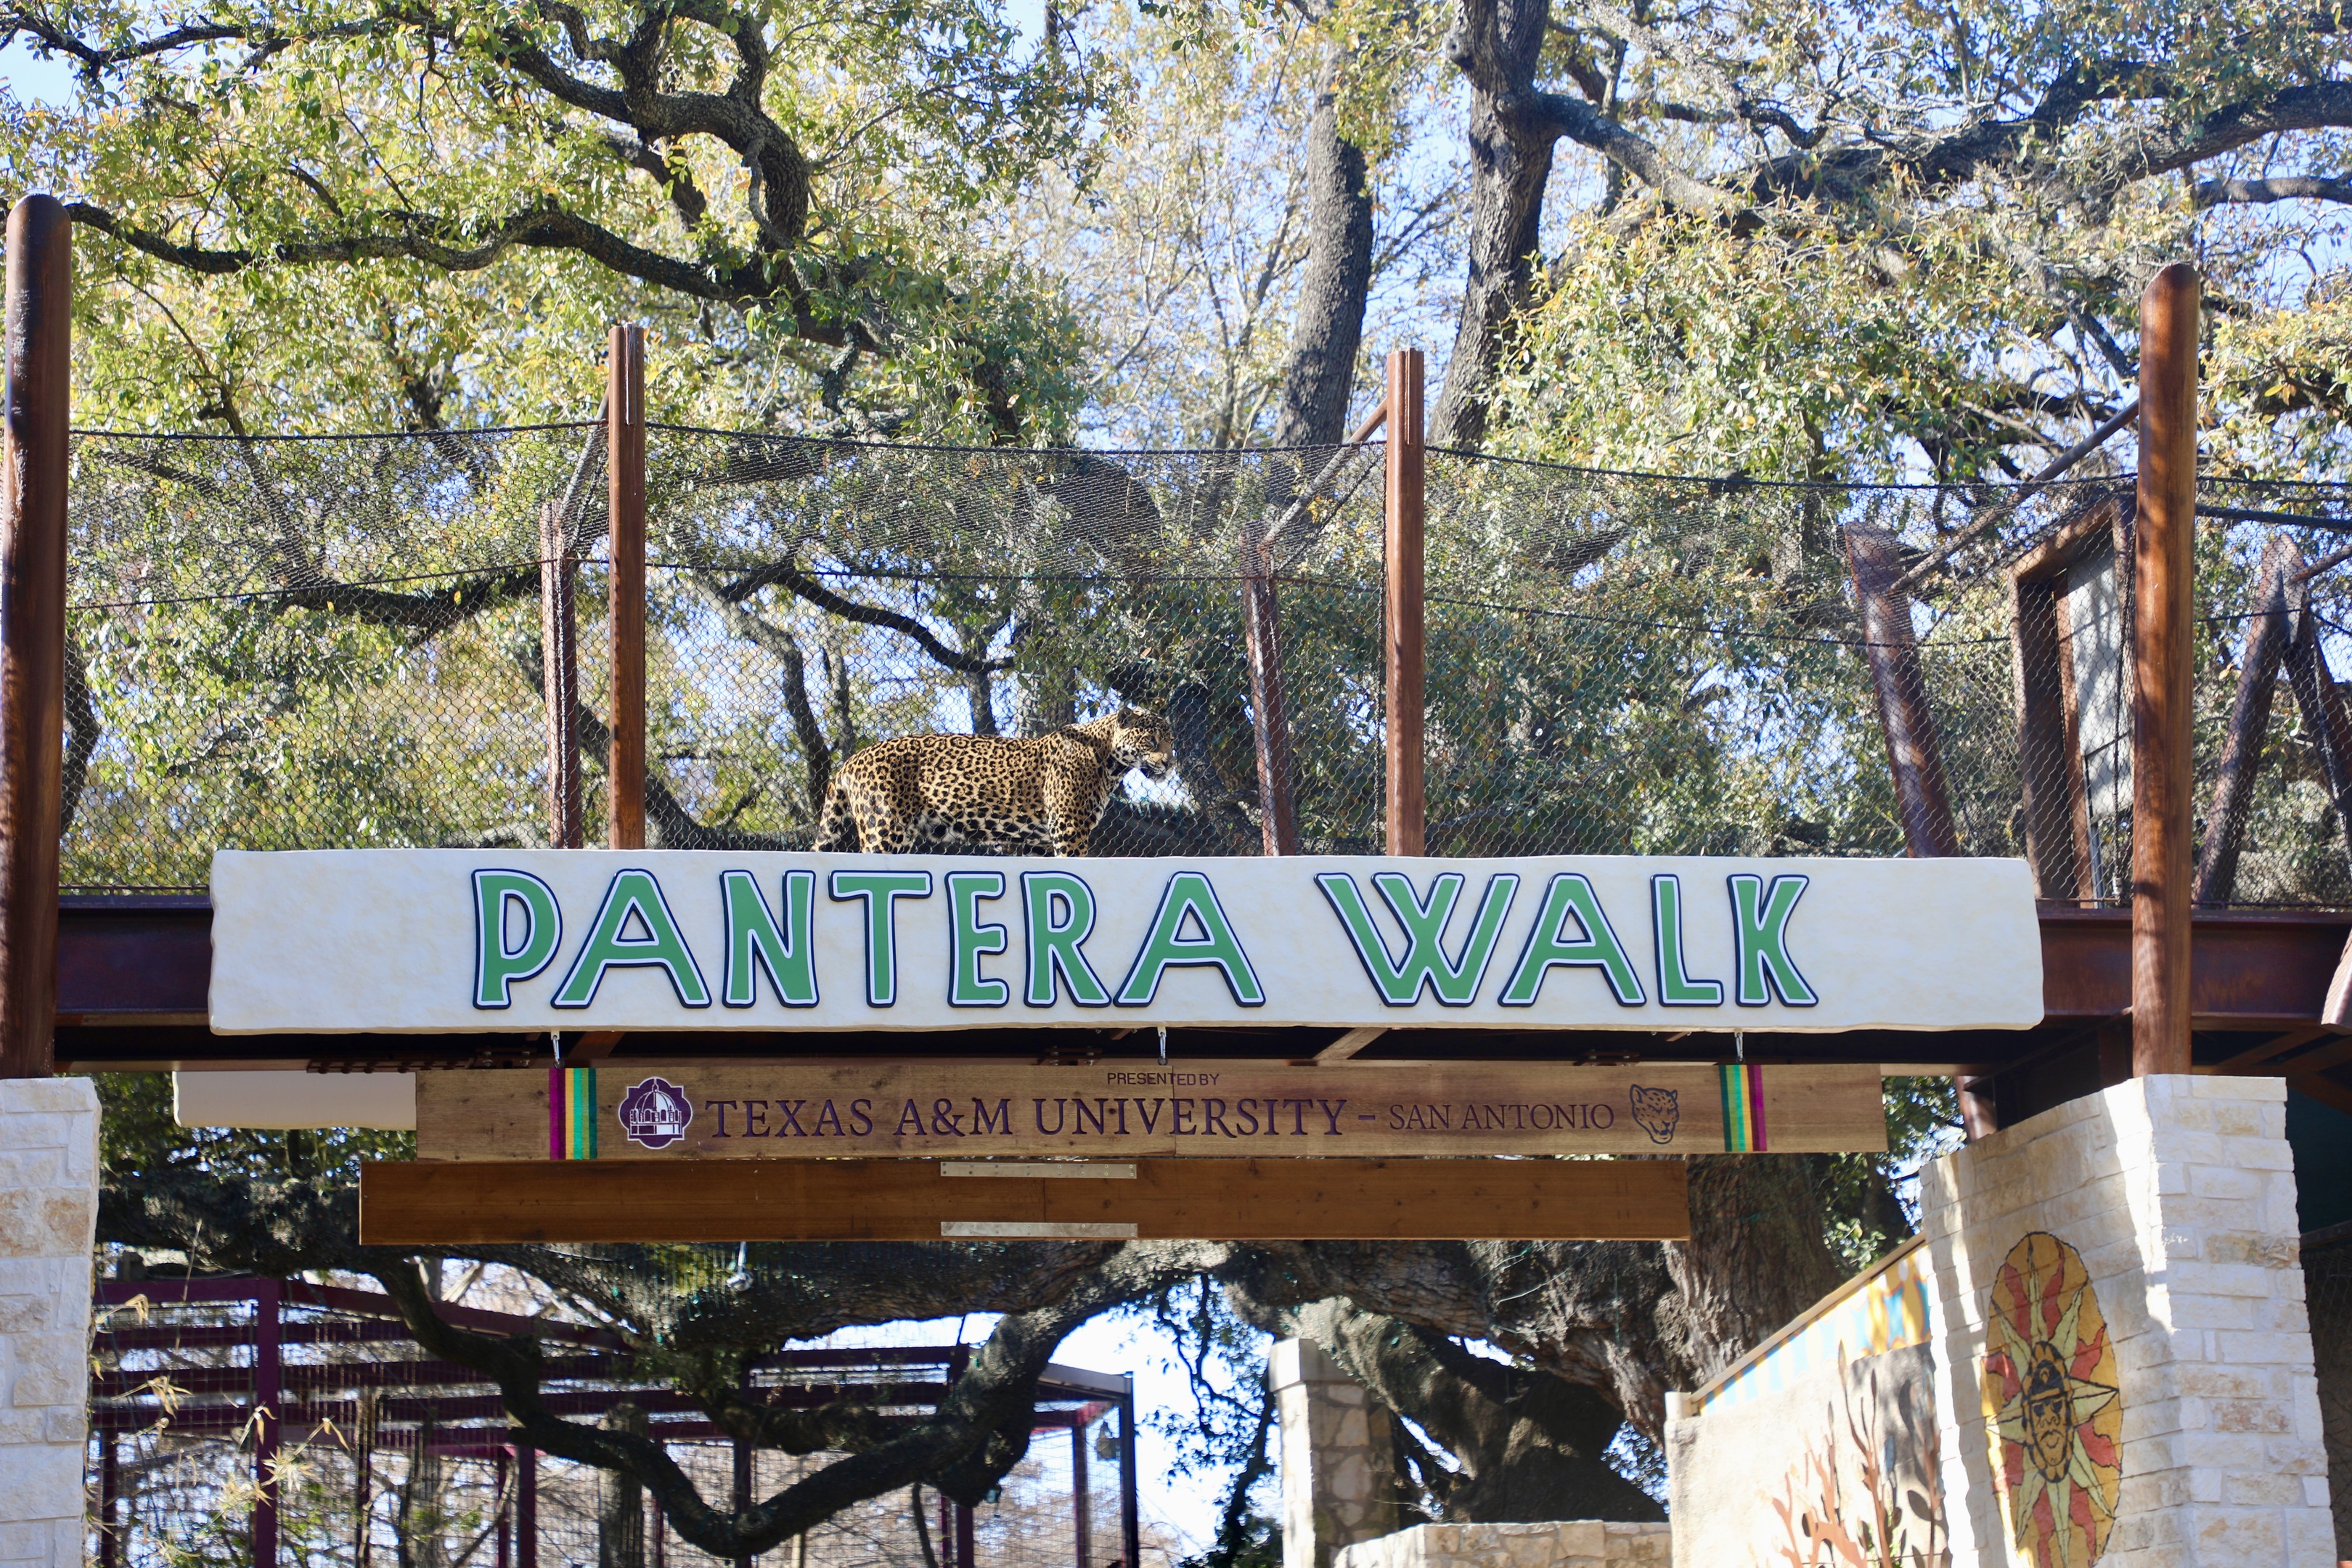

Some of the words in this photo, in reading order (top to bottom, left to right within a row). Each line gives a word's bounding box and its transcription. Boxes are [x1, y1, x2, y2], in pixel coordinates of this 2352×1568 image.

[473, 868, 1266, 1010] PANTERA
[1314, 871, 1818, 1008] WALK
[1107, 1072, 1196, 1086] PRESENTED
[1199, 1074, 1220, 1086] BY
[705, 1098, 874, 1138] TEXAS
[894, 1098, 1012, 1138] A&M
[1032, 1097, 1349, 1138] UNIVERSITY
[1389, 1104, 1451, 1130] SAN
[1462, 1103, 1615, 1130] ANTONIO
